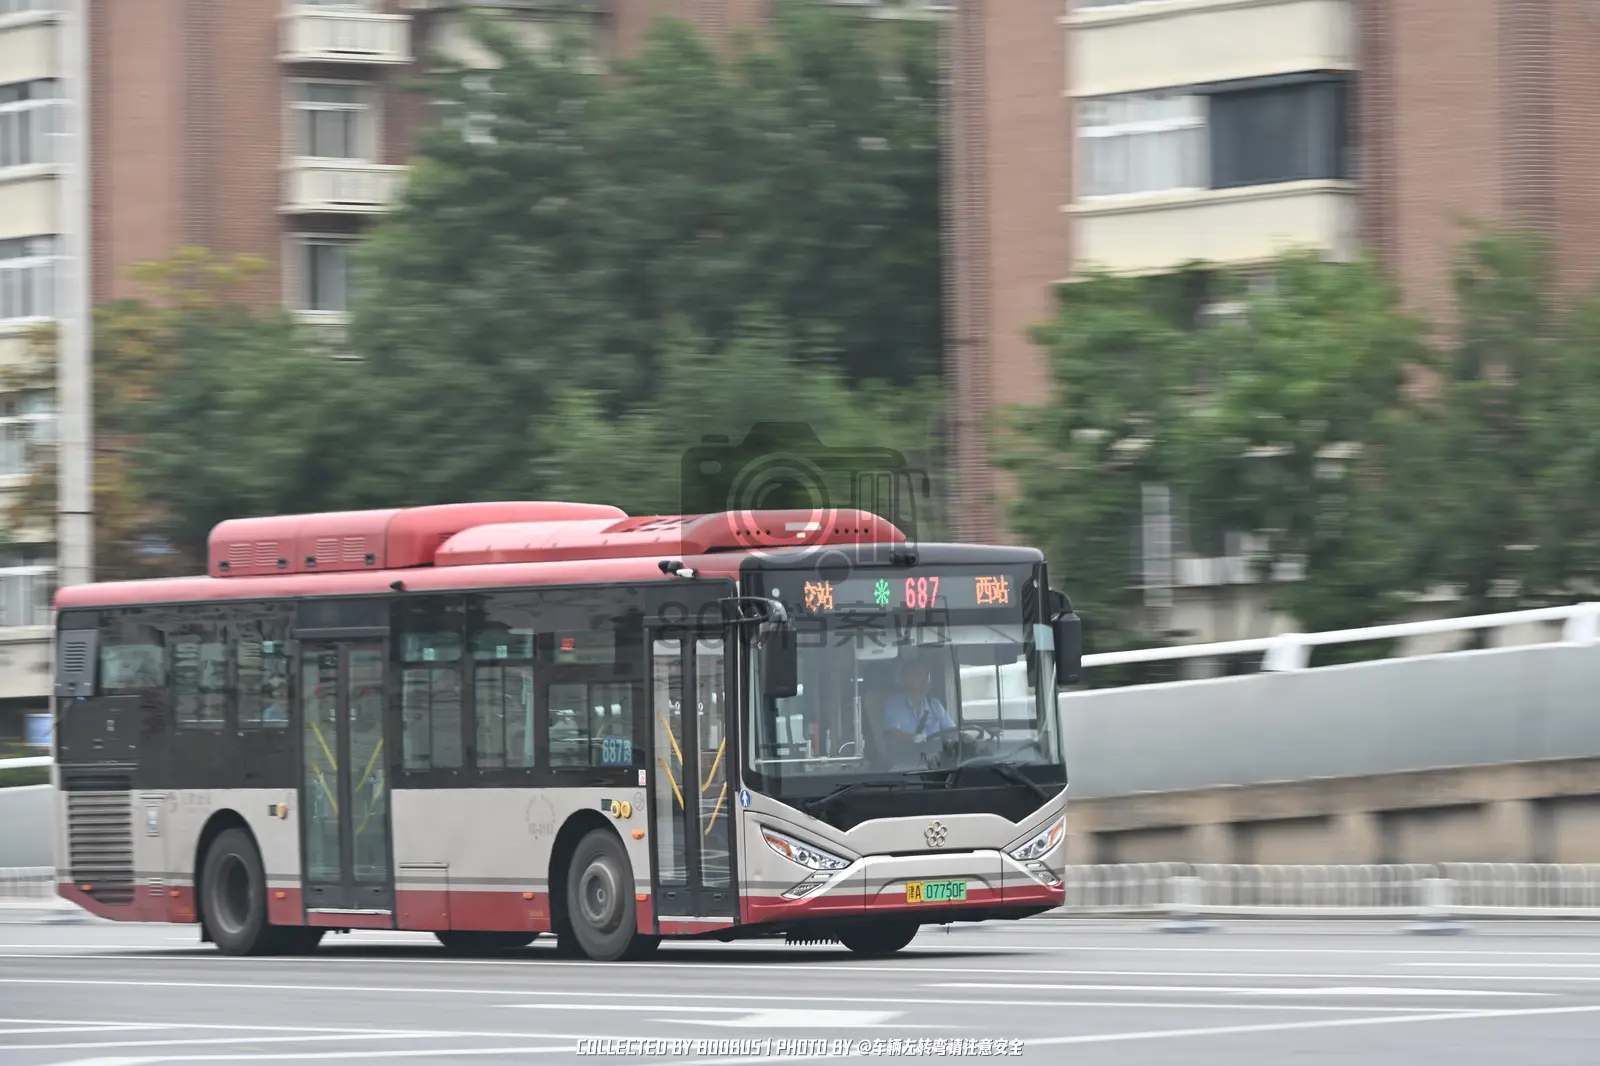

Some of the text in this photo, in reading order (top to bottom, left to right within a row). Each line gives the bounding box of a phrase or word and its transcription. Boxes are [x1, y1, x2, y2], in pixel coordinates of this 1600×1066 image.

[905, 577, 940, 609] 687
[975, 575, 1010, 605] 西站
[926, 883, 965, 899] 07750F
